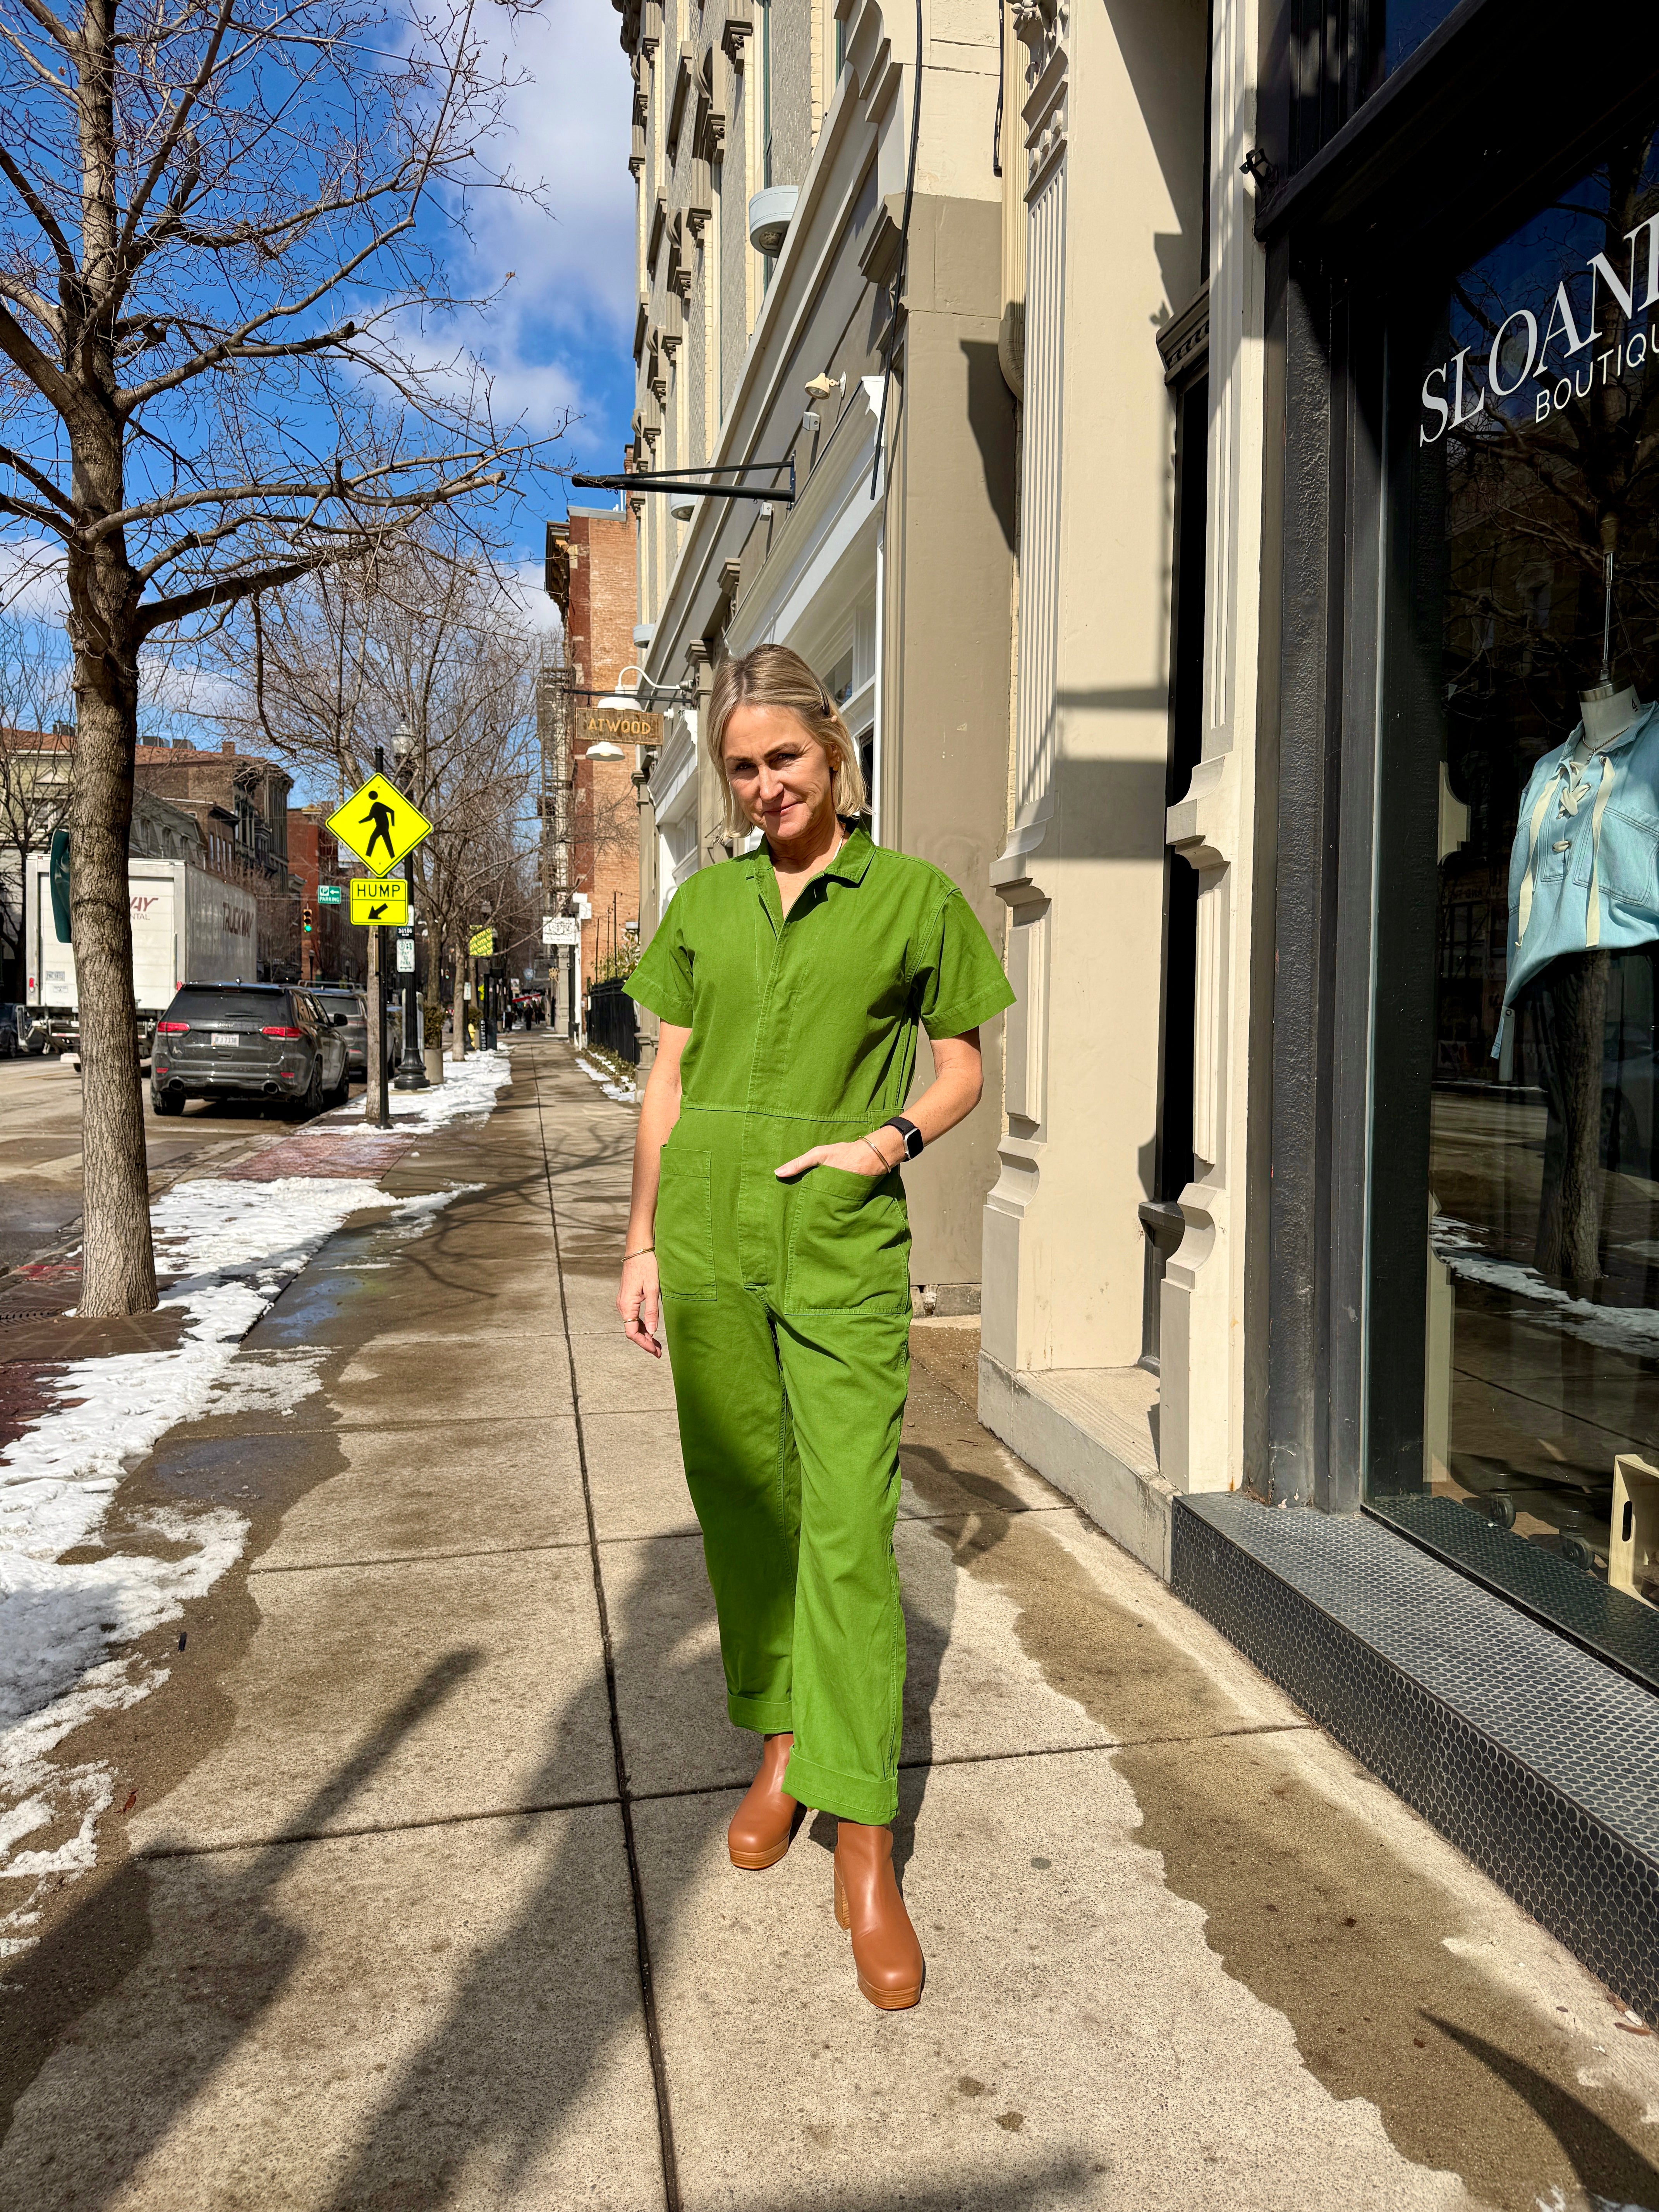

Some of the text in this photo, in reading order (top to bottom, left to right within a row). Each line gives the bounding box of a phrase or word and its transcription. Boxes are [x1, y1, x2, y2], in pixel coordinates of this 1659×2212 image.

[1632, 698, 1638, 712] 4
[588, 717, 651, 735] ATWOOD
[357, 884, 400, 897] HUMP
